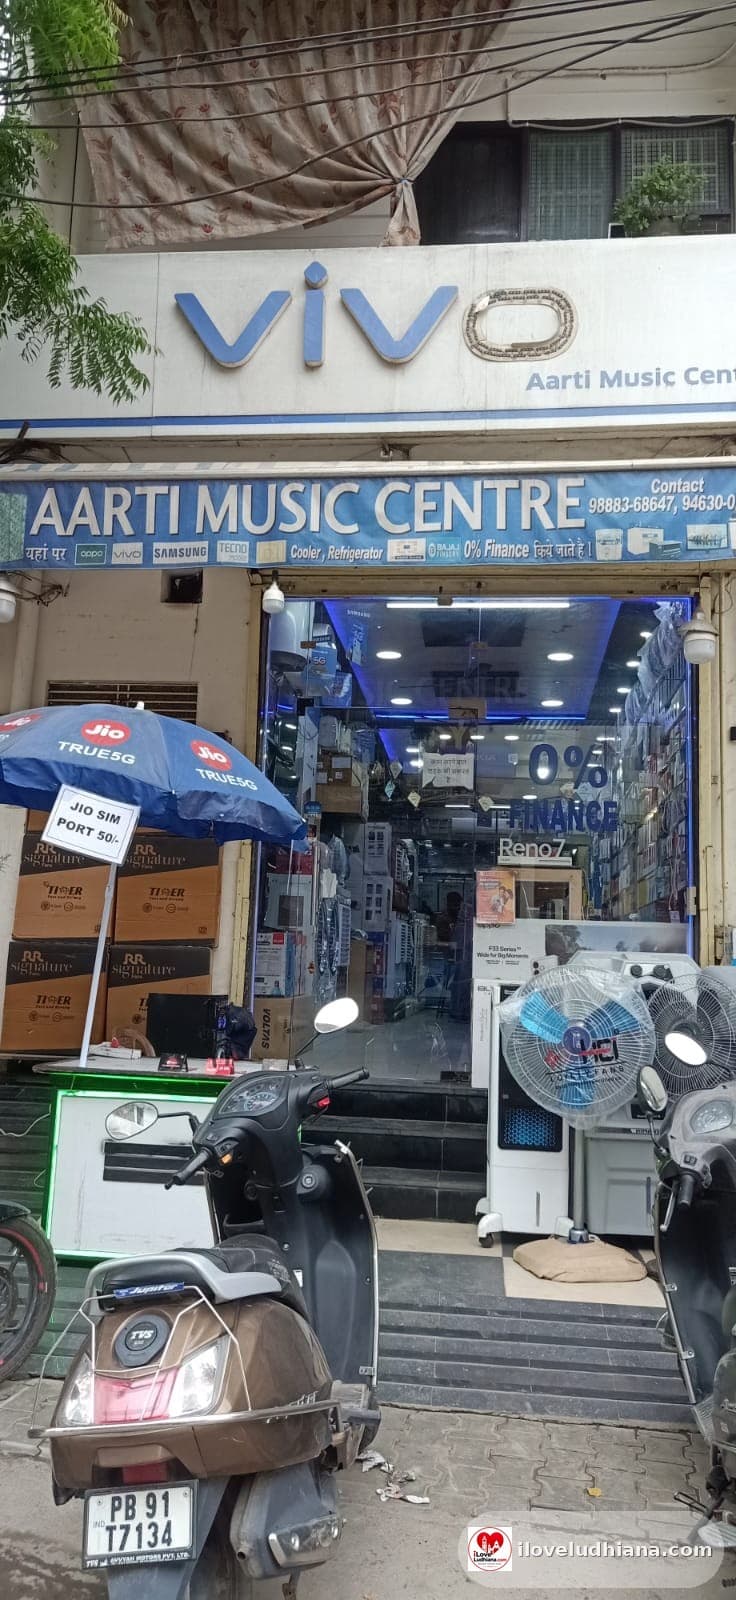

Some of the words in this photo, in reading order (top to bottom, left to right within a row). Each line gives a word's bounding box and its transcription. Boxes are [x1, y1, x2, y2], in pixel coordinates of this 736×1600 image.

[174, 260, 579, 370] vivo
[525, 370, 592, 391] Aarti
[600, 367, 676, 389] Music
[650, 476, 705, 494] Contact
[29, 485, 181, 536] AARTI
[195, 483, 361, 535] MUSIC
[374, 478, 587, 534] CENTRE
[588, 495, 679, 516] 98883-68647,
[682, 494, 736, 511] 94630-0
[52, 548, 68, 561] पर
[154, 546, 208, 559] SAMSUNG
[218, 542, 247, 554] TECNO
[290, 544, 321, 559] Cooler
[328, 545, 384, 563] Refrigerator
[464, 539, 481, 558] 0%
[484, 538, 530, 558] Finance
[85, 724, 125, 740] Jio
[57, 740, 136, 766] TRUE5G
[197, 746, 226, 764] Jio
[528, 743, 609, 789] 0%
[195, 768, 258, 791] TRUE5G
[69, 802, 93, 816] JIO
[96, 810, 122, 825] SIM
[509, 798, 619, 833] FINANCE
[56, 817, 95, 838] PORT
[97, 830, 120, 845] 50/-
[133, 844, 157, 856] RR
[23, 852, 86, 868] signature
[22, 950, 44, 962] RR
[123, 953, 147, 965] RR
[10, 961, 73, 976] signature
[111, 963, 177, 979] signature
[261, 1008, 272, 1049] VOLTAS
[130, 1329, 155, 1340] TVS
[111, 1494, 137, 1522] PB
[145, 1491, 170, 1519] 91
[105, 1520, 173, 1552] T7134
